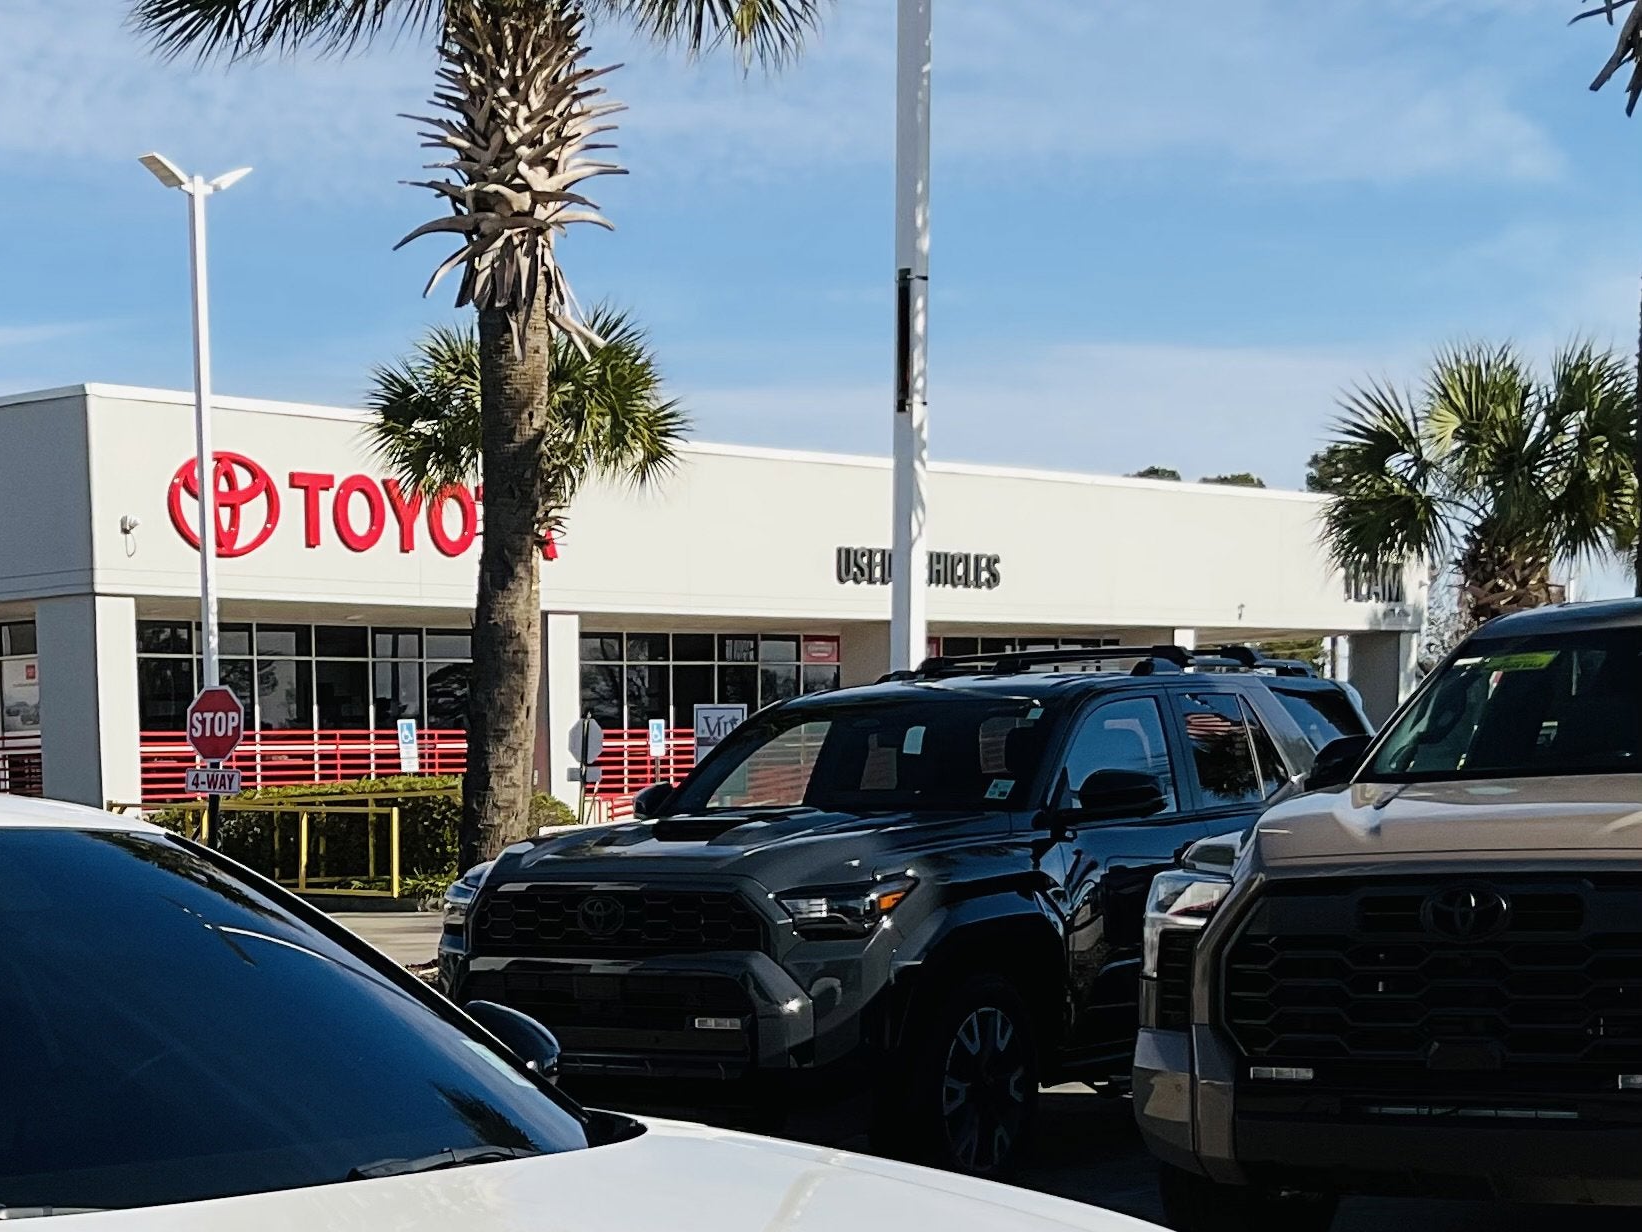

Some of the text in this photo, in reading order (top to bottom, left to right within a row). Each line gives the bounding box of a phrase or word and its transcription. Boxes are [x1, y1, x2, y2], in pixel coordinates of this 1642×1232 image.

[289, 471, 558, 561] TOYO
[925, 551, 1001, 590] HICLES
[191, 711, 239, 737] STOP
[191, 773, 235, 790] 4-WAY
